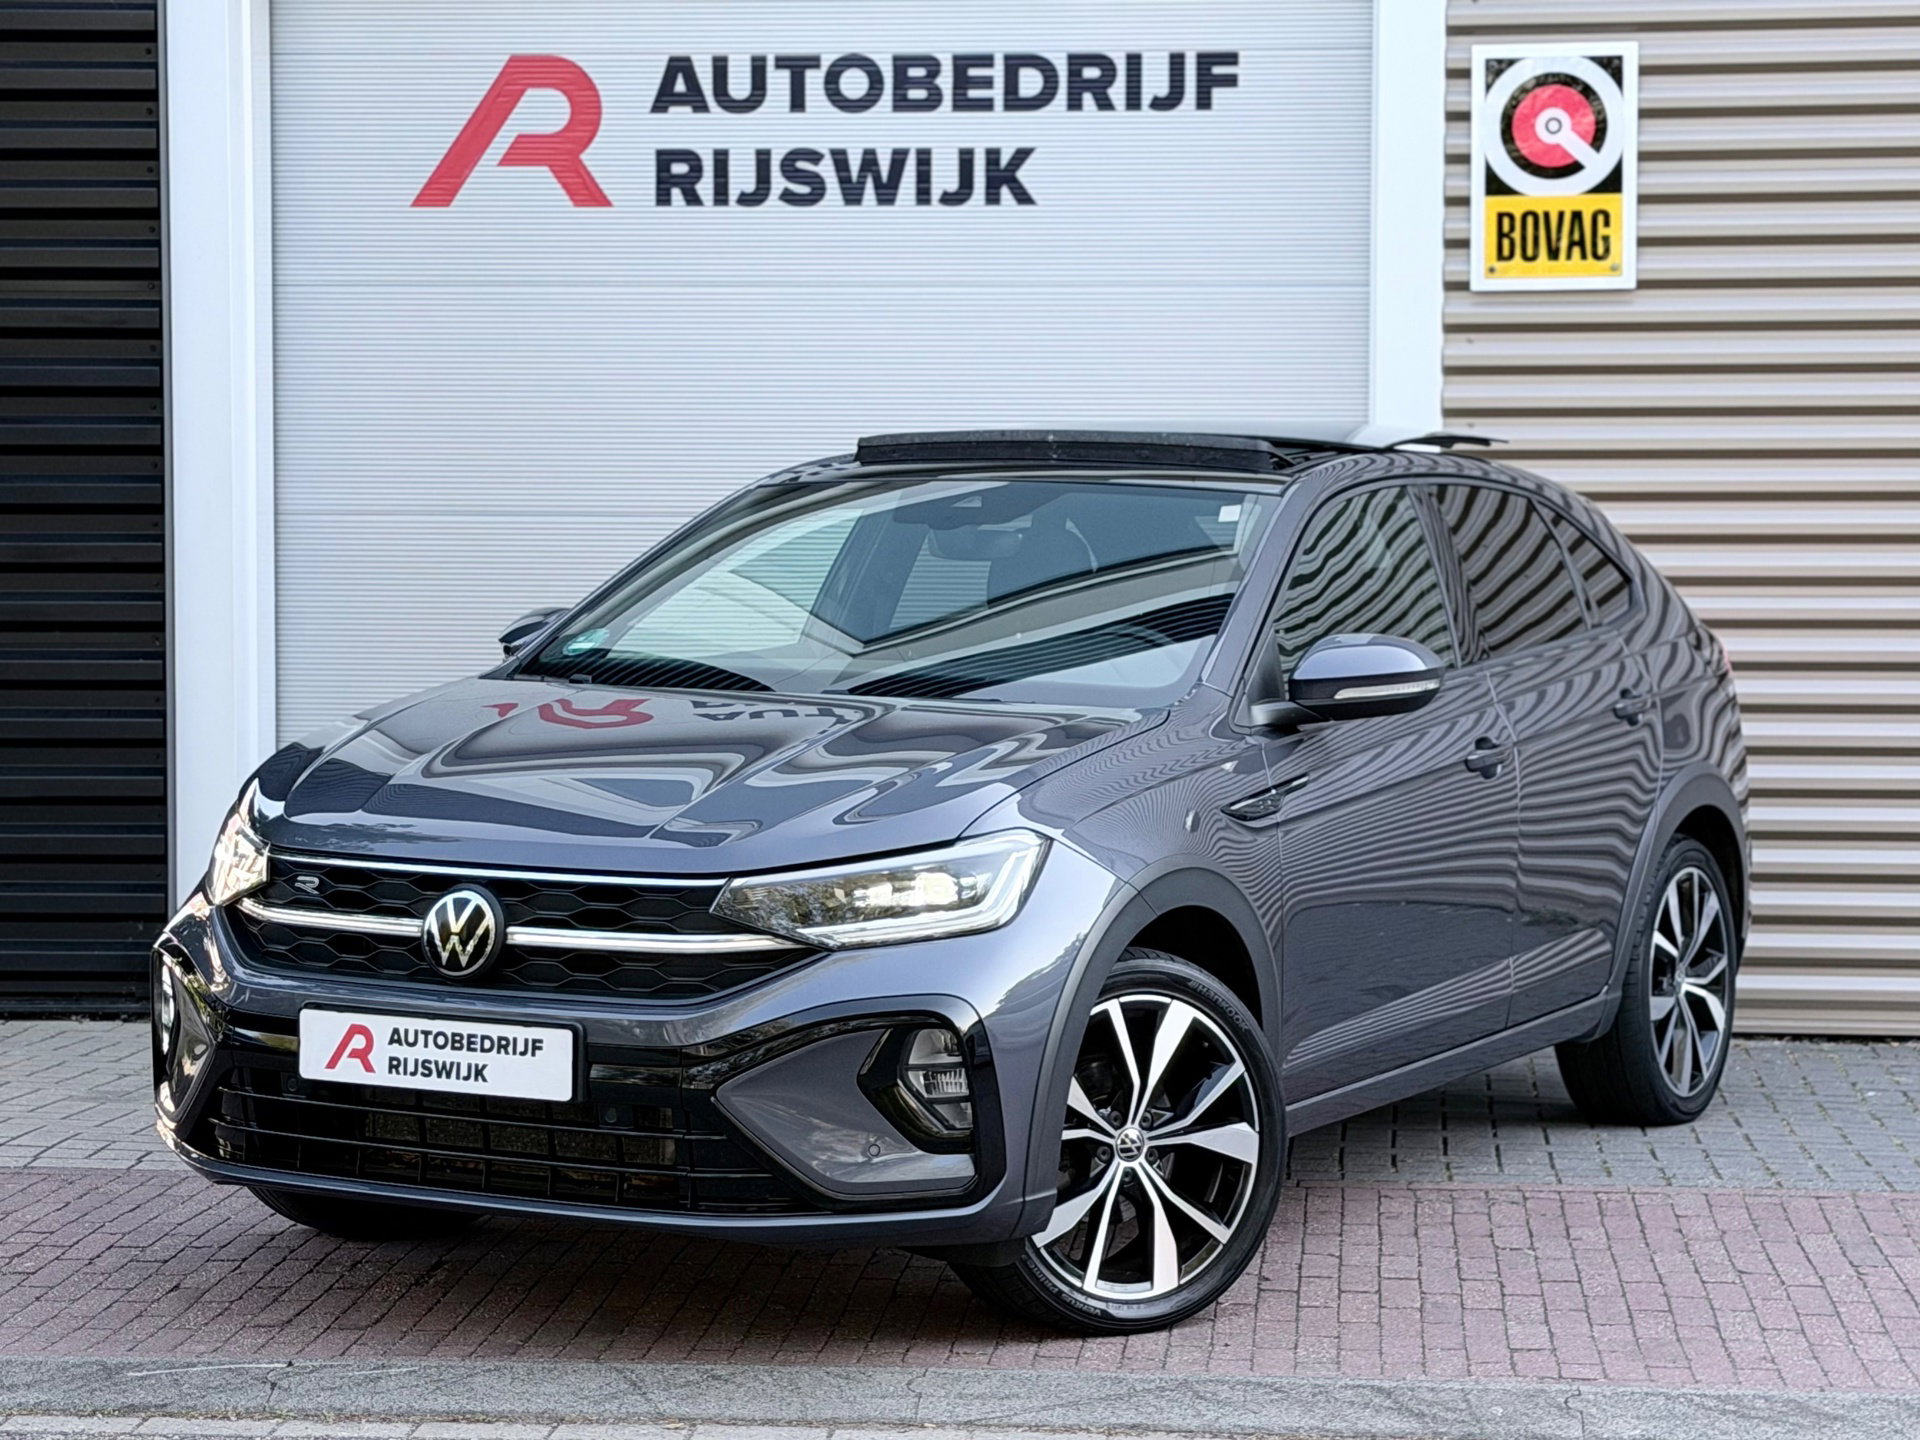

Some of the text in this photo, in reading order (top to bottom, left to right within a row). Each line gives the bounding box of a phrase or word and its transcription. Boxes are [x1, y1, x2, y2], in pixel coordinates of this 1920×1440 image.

[650, 52, 1239, 114] AUTOBEDRIJF
[655, 147, 1037, 207] RIJSWIJK
[1496, 209, 1612, 263] BOVAG
[387, 1027, 544, 1057] AUTOBEDRIJF
[387, 1056, 488, 1083] RIJSWIJK
